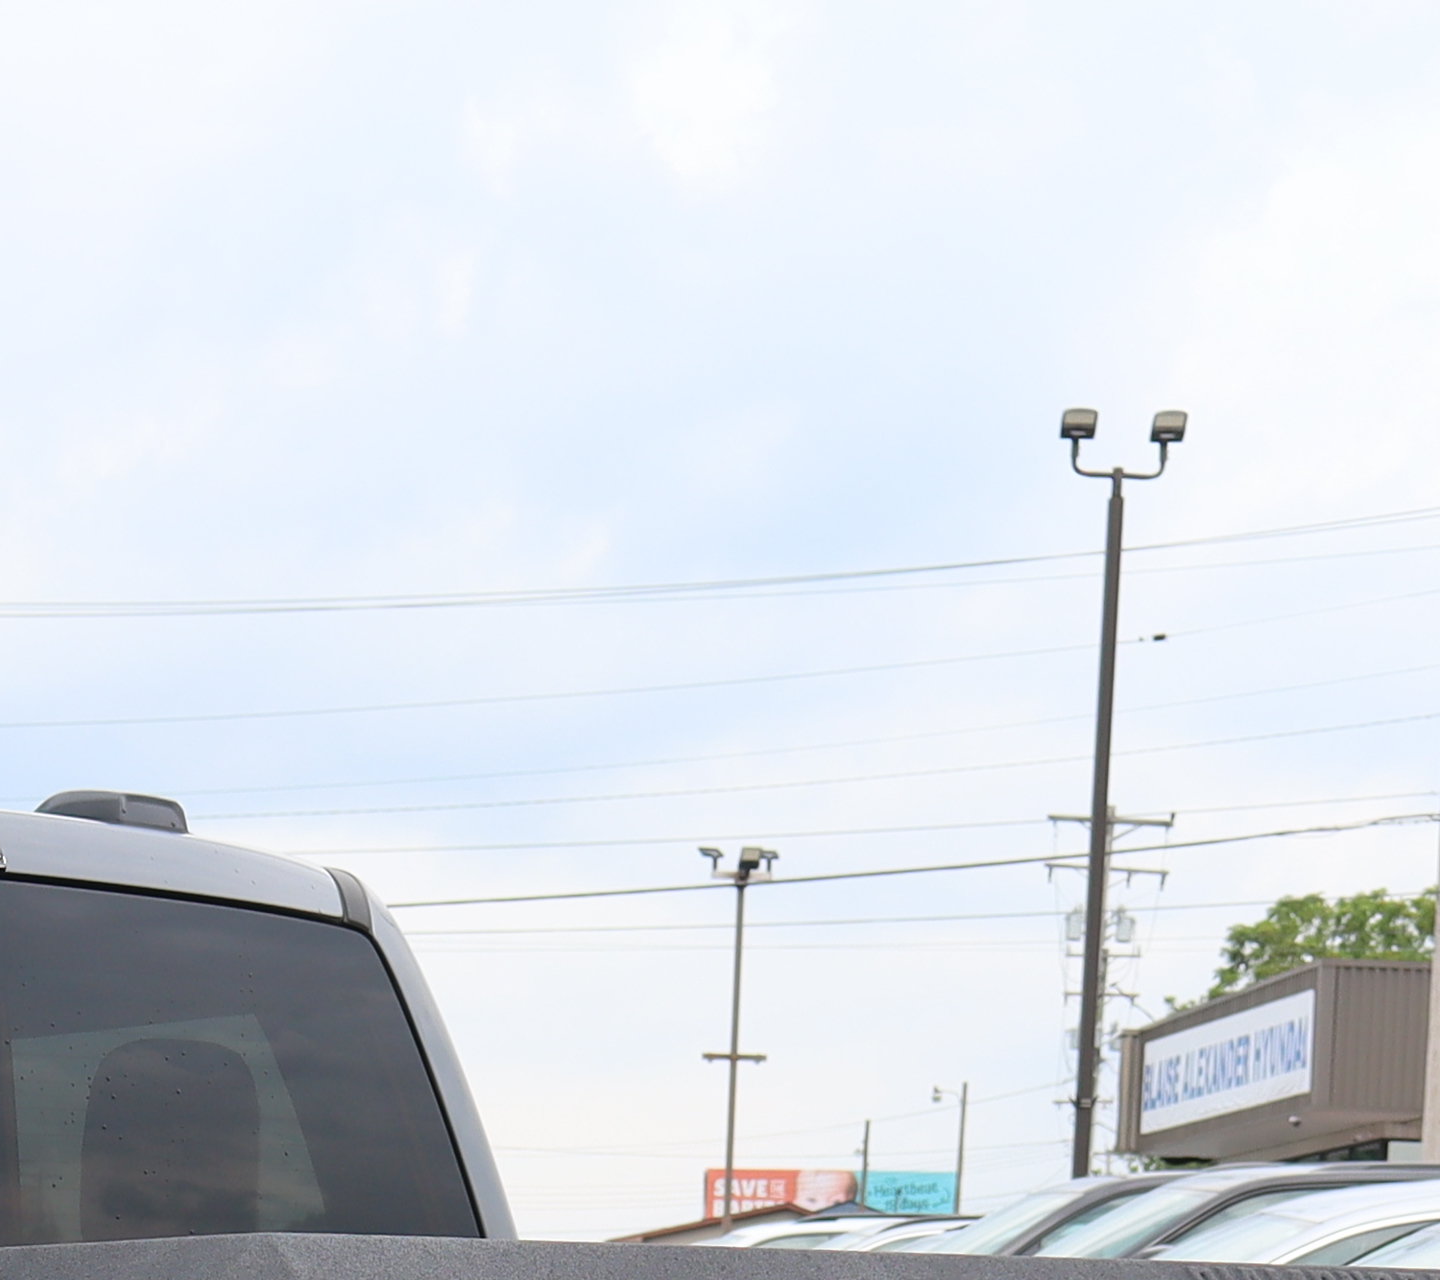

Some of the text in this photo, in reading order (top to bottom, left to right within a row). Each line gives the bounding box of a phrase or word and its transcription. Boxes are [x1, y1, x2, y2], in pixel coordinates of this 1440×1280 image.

[1143, 1015, 1309, 1112] BLAISE ALEXANDER HYUNDAI
[713, 1178, 769, 1198] SAVE
